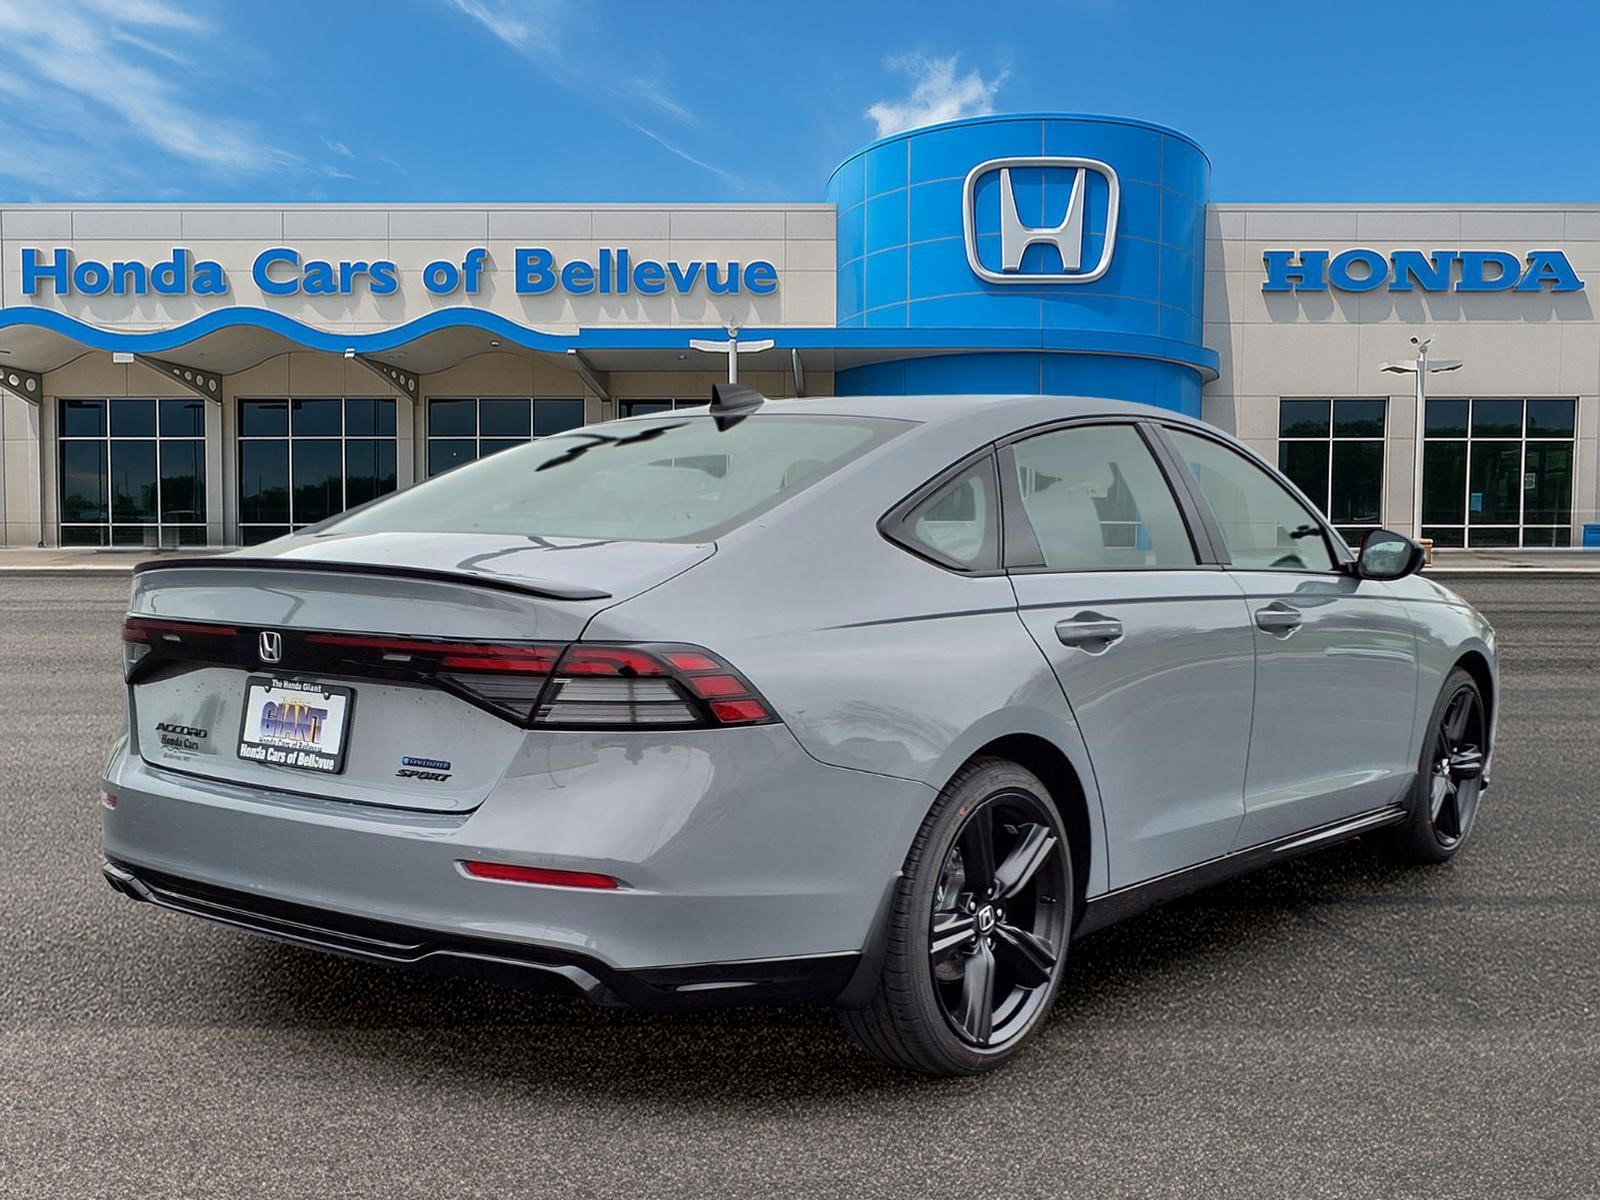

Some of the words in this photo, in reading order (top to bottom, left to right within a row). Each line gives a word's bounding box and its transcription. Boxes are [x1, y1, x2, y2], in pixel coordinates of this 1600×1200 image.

[20, 247, 228, 297] Honda
[251, 247, 399, 297] Cars
[422, 247, 488, 296] of
[513, 247, 779, 297] Bellevue
[1261, 248, 1585, 294] HONDA
[271, 679, 283, 688] The
[283, 680, 302, 690] Honda
[302, 682, 322, 693] Giant
[155, 722, 208, 739] ACCORD
[261, 701, 328, 743] GIANT
[240, 743, 266, 760] Honda
[267, 747, 286, 763] Cars
[286, 750, 298, 765] of
[297, 752, 335, 771] Bellevue
[395, 768, 453, 782] SPORT
